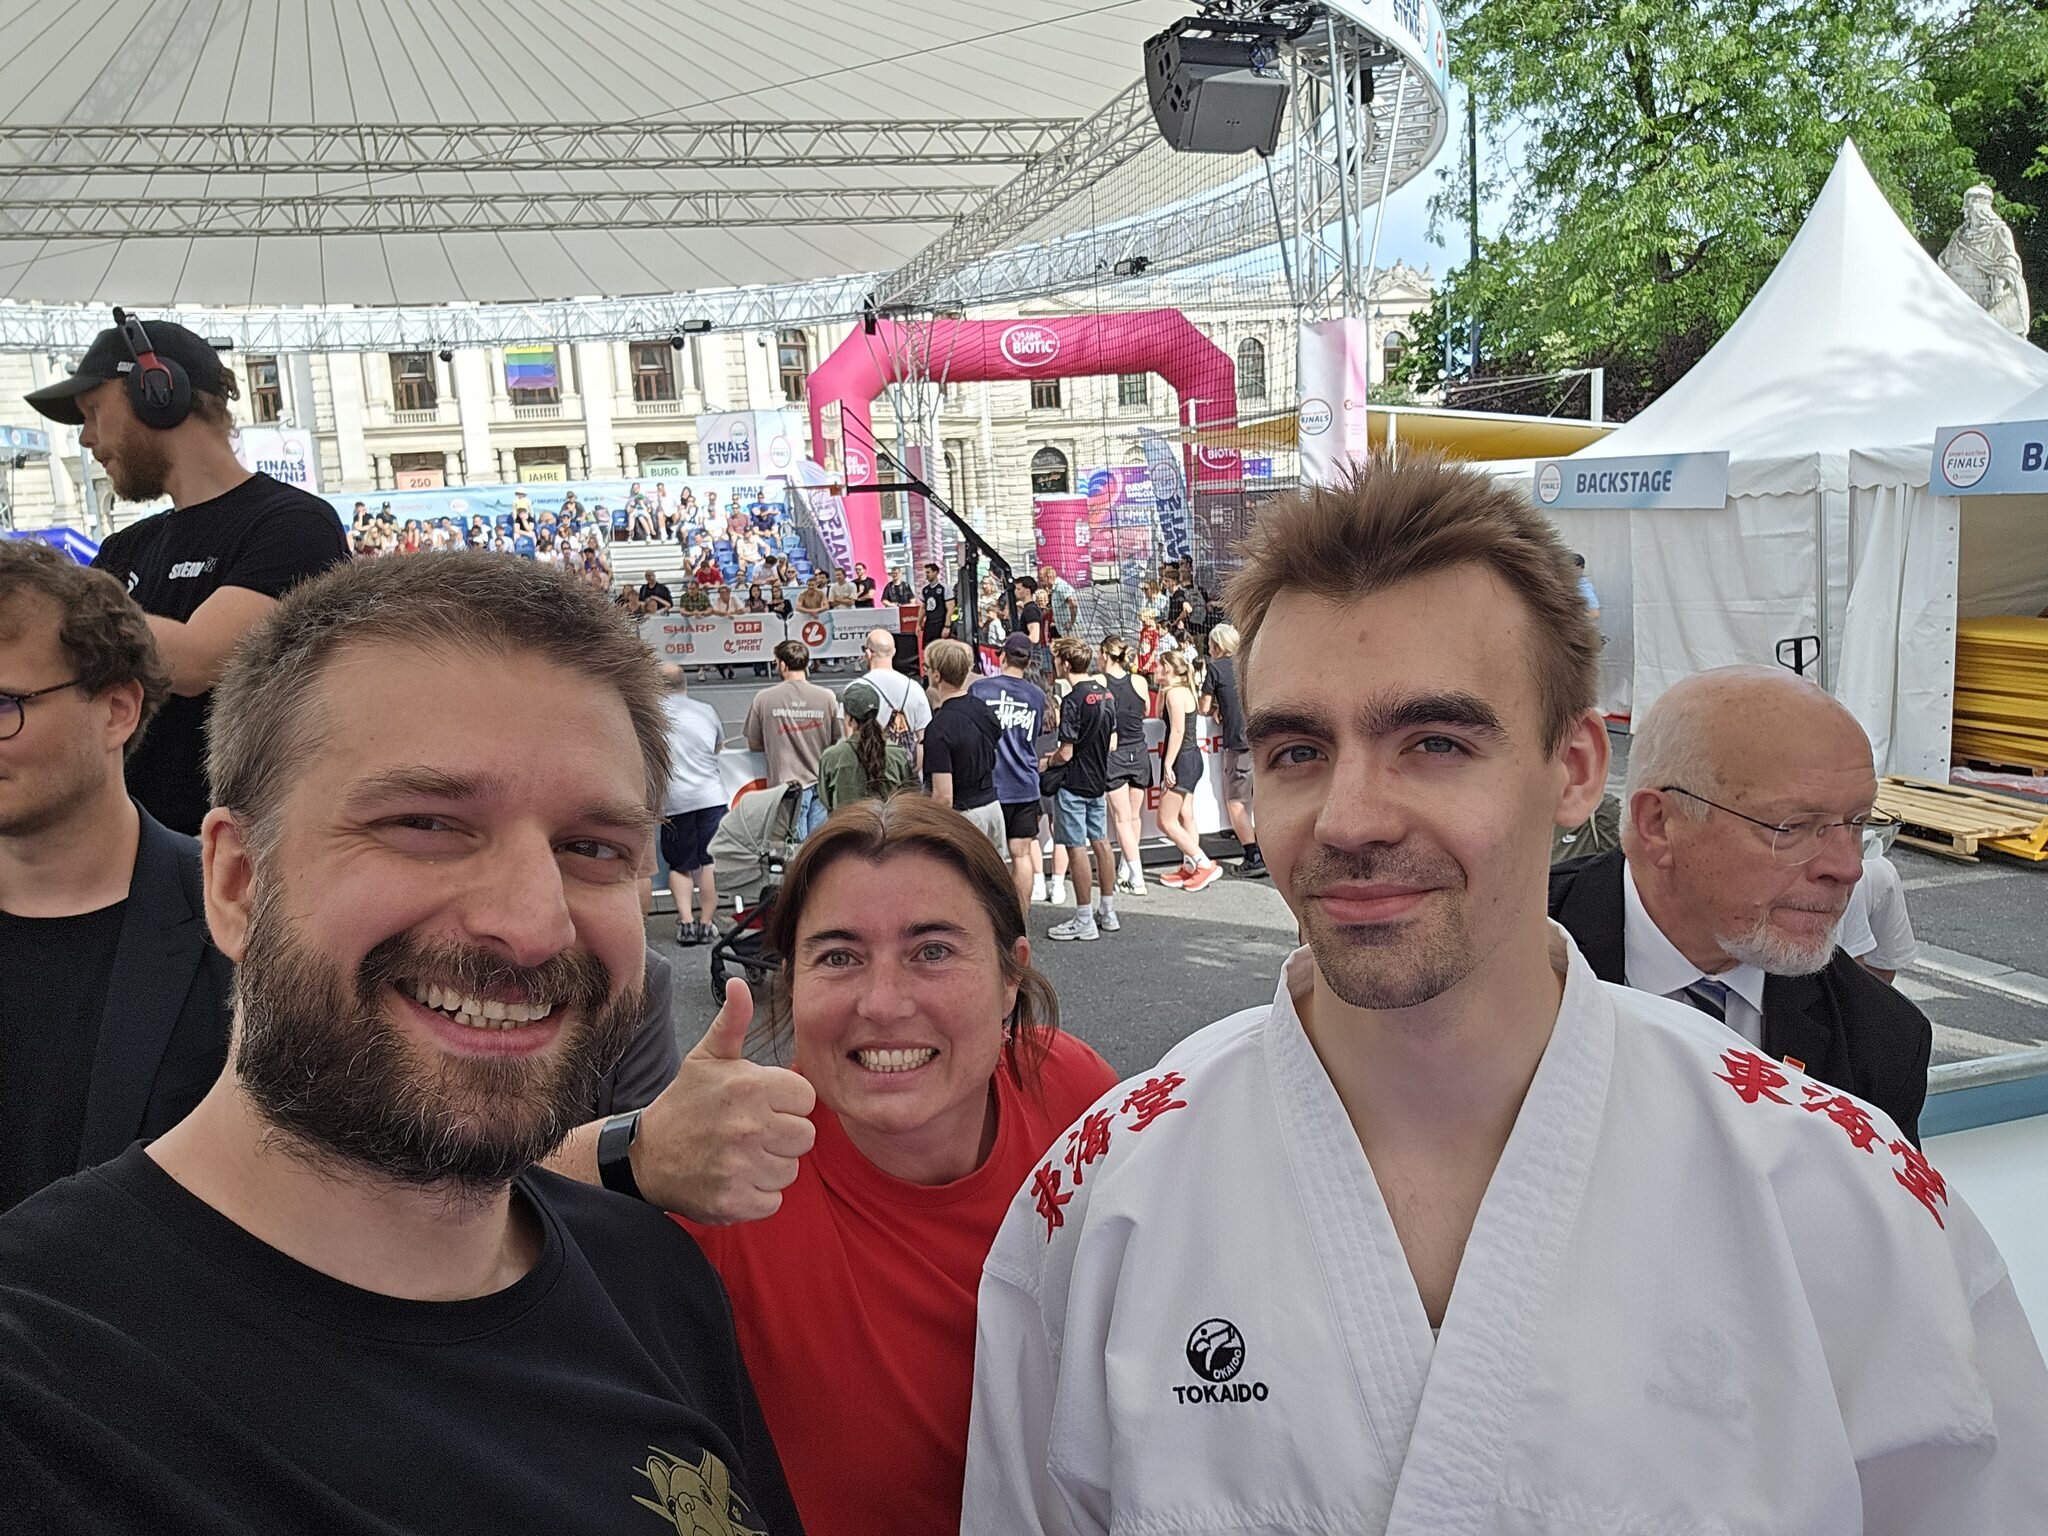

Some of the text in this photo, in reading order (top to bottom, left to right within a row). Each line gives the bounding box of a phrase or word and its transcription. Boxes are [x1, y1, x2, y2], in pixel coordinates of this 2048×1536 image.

[707, 439, 750, 454] FINALS
[1946, 457, 1986, 469] FINALS
[528, 471, 559, 482] JAHRE
[650, 467, 679, 477] BURG
[410, 478, 431, 488] 250
[1576, 469, 1673, 493] BACKSTAGE
[662, 624, 716, 634] SHARP
[735, 622, 761, 632] ORF
[735, 638, 763, 647] SPORT
[665, 642, 695, 655] ÖBB
[1173, 1382, 1269, 1404] TOKAIDO
